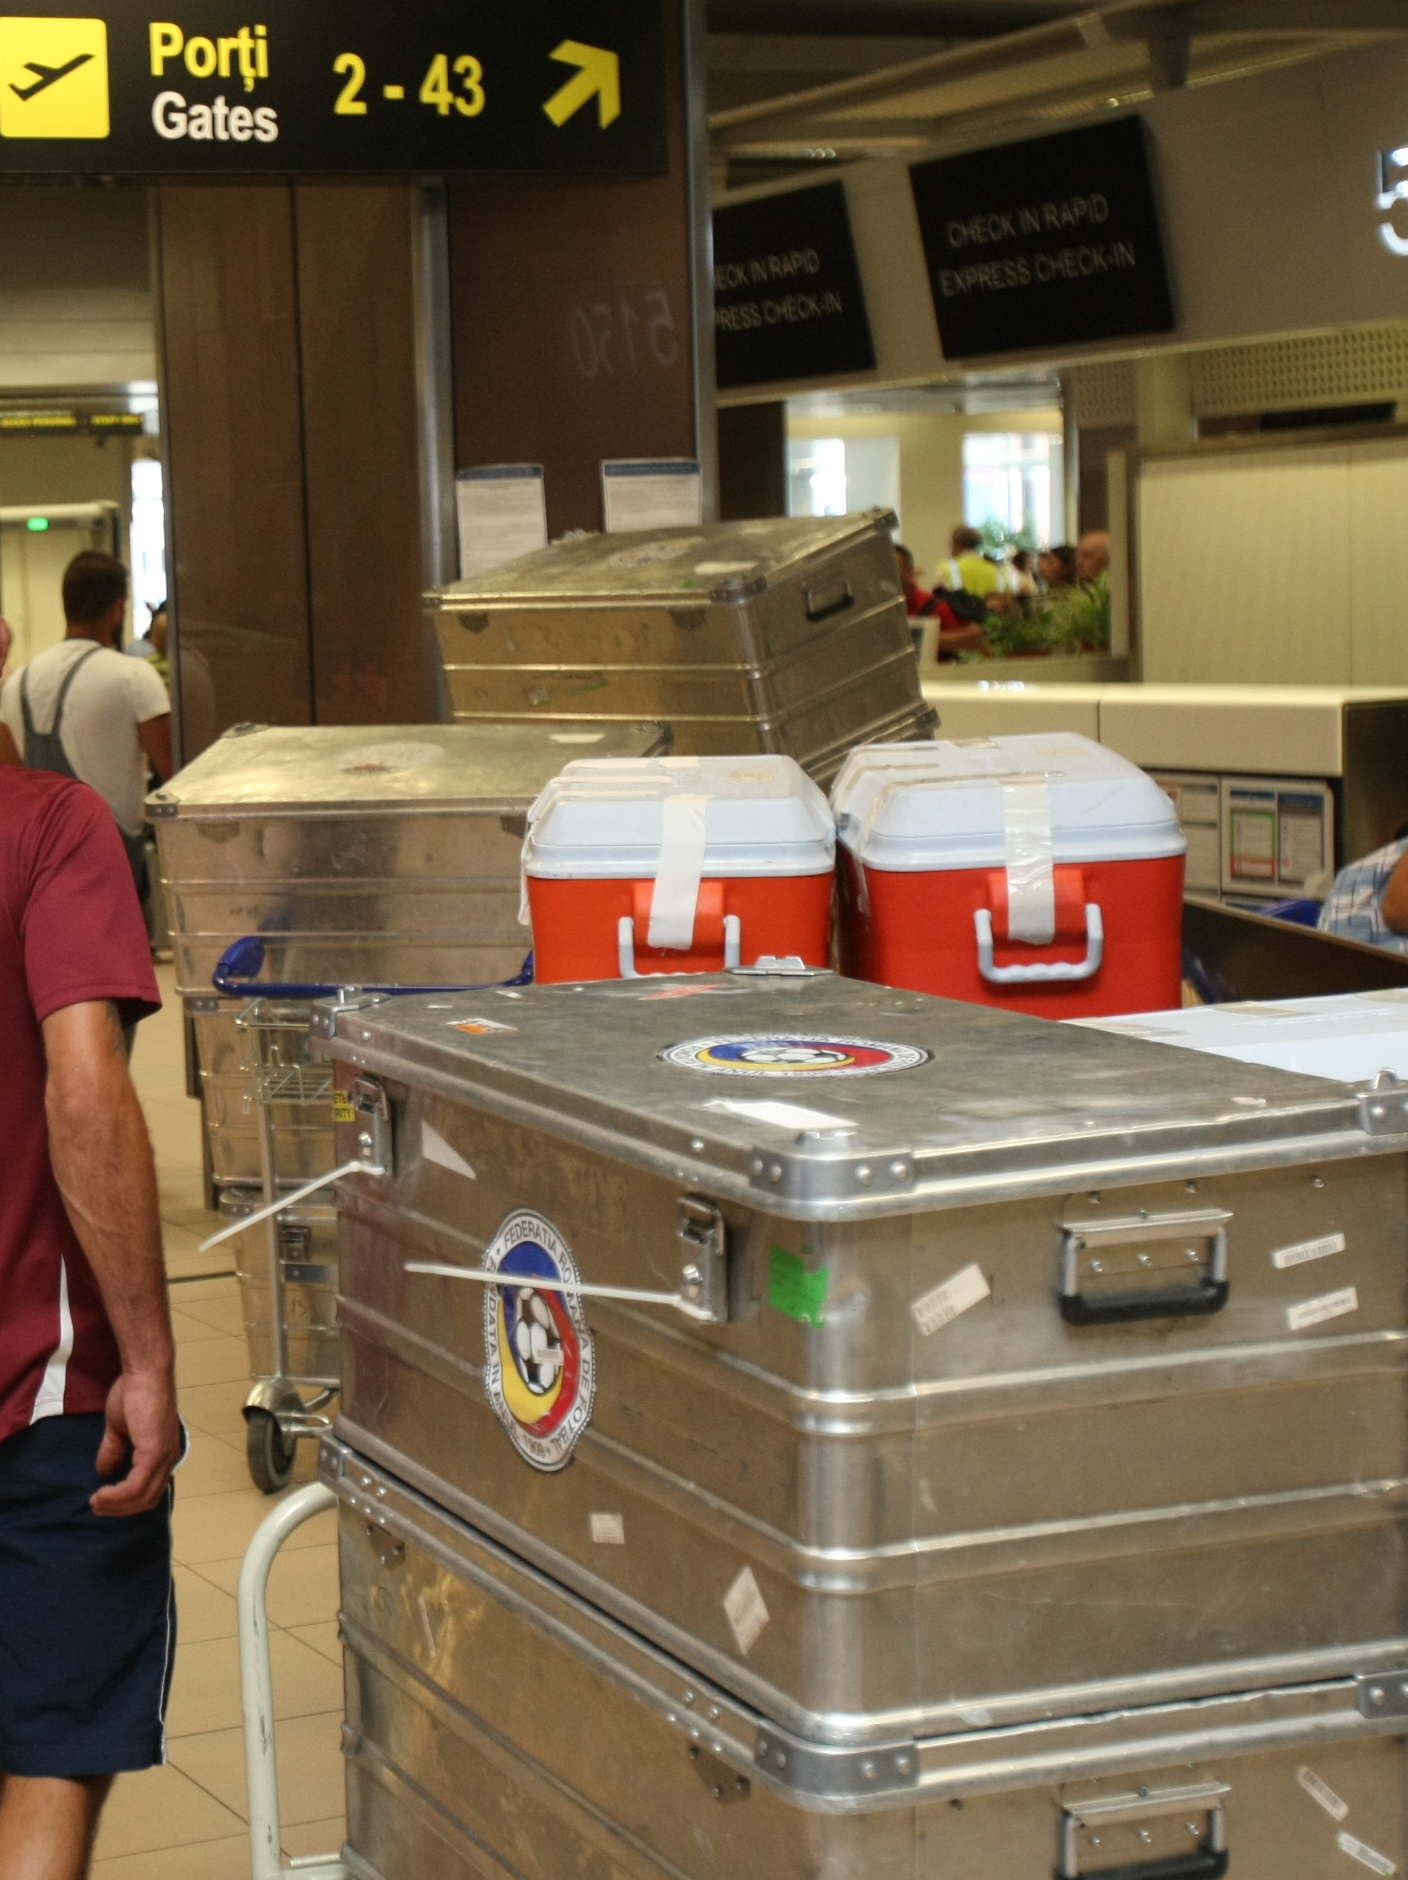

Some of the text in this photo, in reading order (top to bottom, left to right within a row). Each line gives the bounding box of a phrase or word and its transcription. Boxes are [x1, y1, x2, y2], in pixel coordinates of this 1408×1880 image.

[148, 21, 269, 92] Porți
[332, 52, 367, 115] 2
[418, 53, 486, 117] 43
[151, 91, 279, 143] Gates
[947, 192, 1110, 249] CHECK IN RAPID
[767, 247, 821, 278] RAPID
[939, 240, 1137, 298] EXPRESS CHECK-IN
